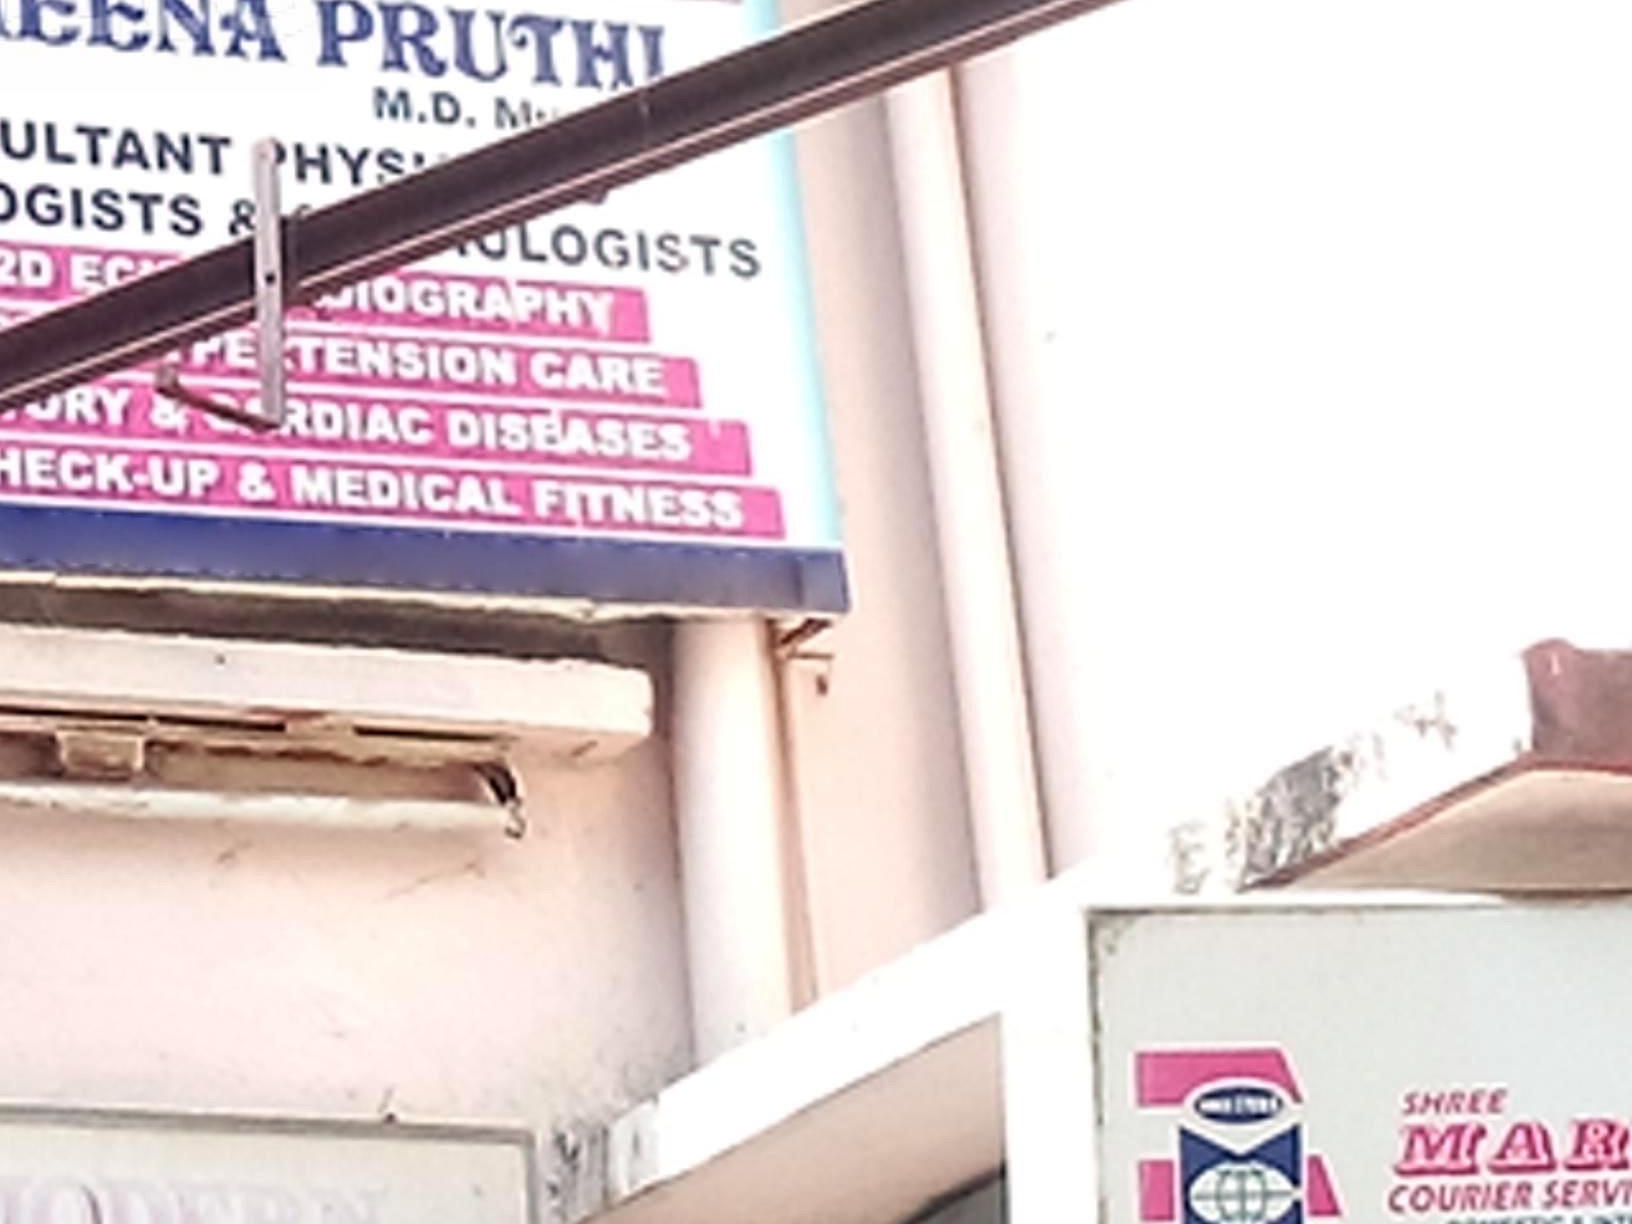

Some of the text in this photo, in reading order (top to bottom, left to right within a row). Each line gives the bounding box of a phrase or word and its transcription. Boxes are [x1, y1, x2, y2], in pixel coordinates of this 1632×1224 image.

[373, 88, 477, 129] M.D.
[530, 353, 668, 396] CARE
[447, 415, 692, 462] DISEASES
[238, 463, 276, 502] &
[291, 468, 521, 518] MEDICAL
[531, 481, 744, 529] FITNESS
[1401, 1087, 1508, 1117] SHREE
[1387, 1181, 1535, 1214] COURIER
